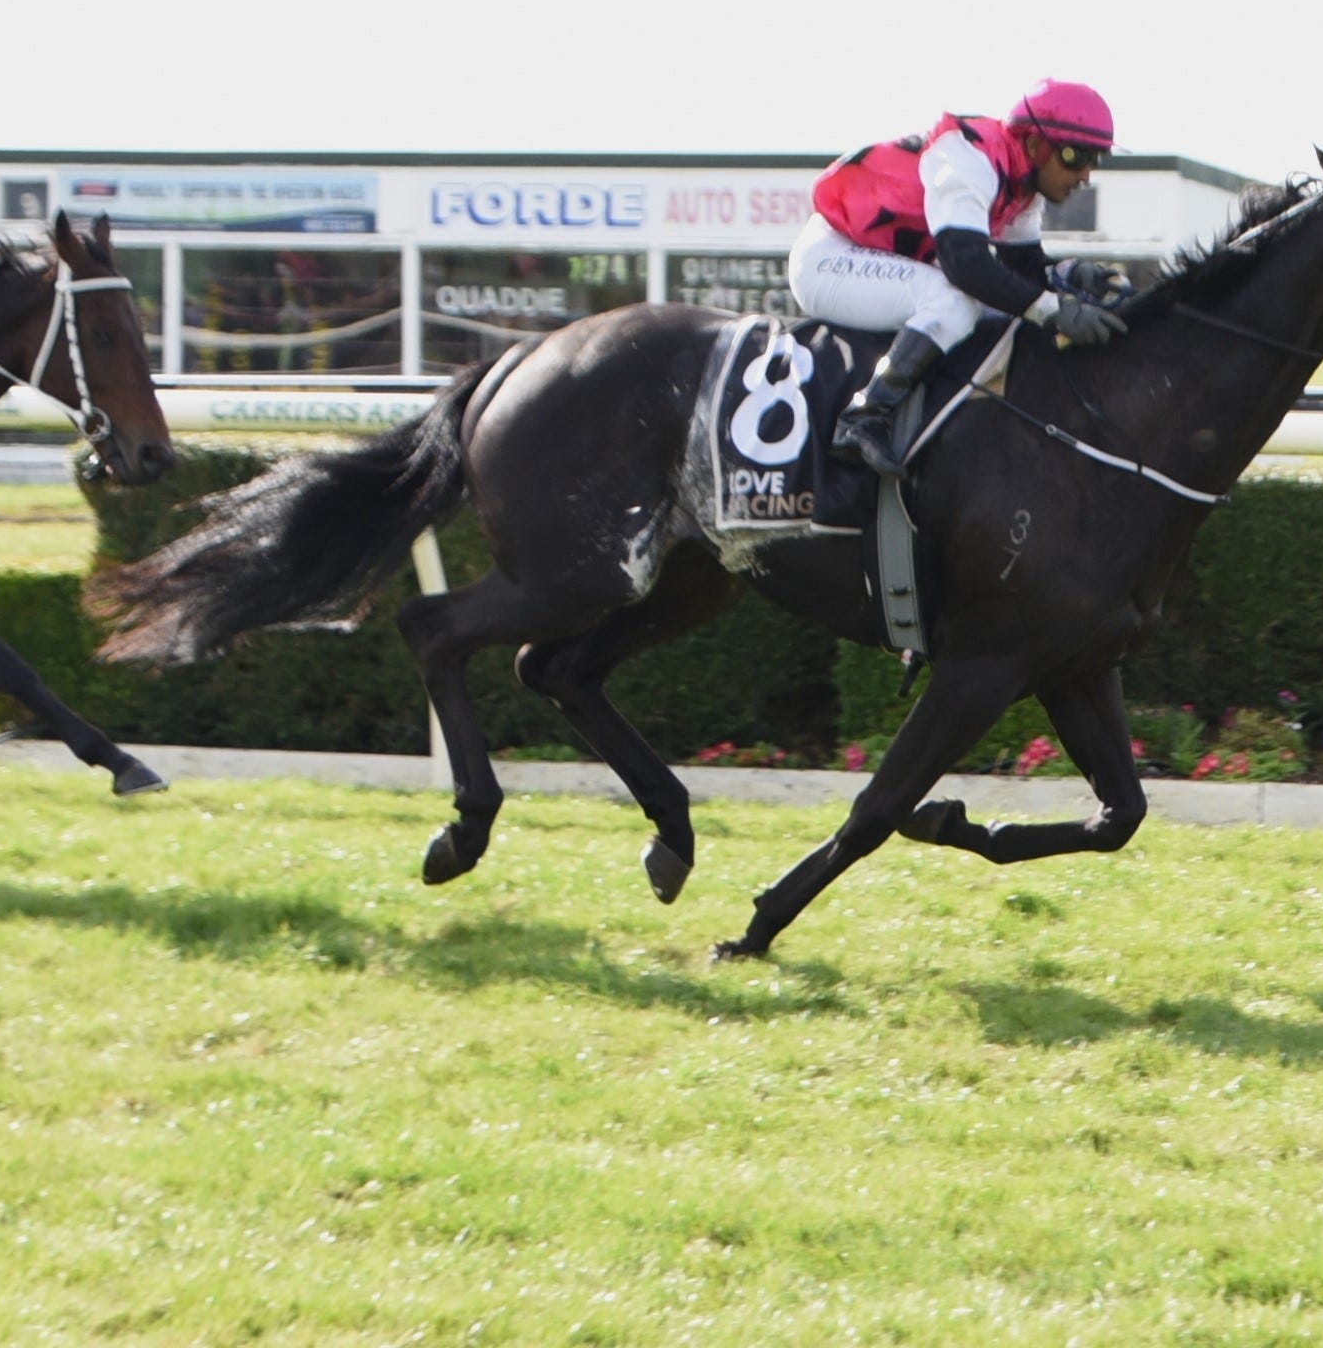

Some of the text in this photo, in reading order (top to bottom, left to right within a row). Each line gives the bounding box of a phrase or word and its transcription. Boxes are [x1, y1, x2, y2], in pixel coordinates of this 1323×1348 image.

[431, 182, 646, 227] FORDE
[665, 188, 735, 225] AUTO
[435, 285, 567, 317] QUADDIE
[730, 332, 815, 465] 8
